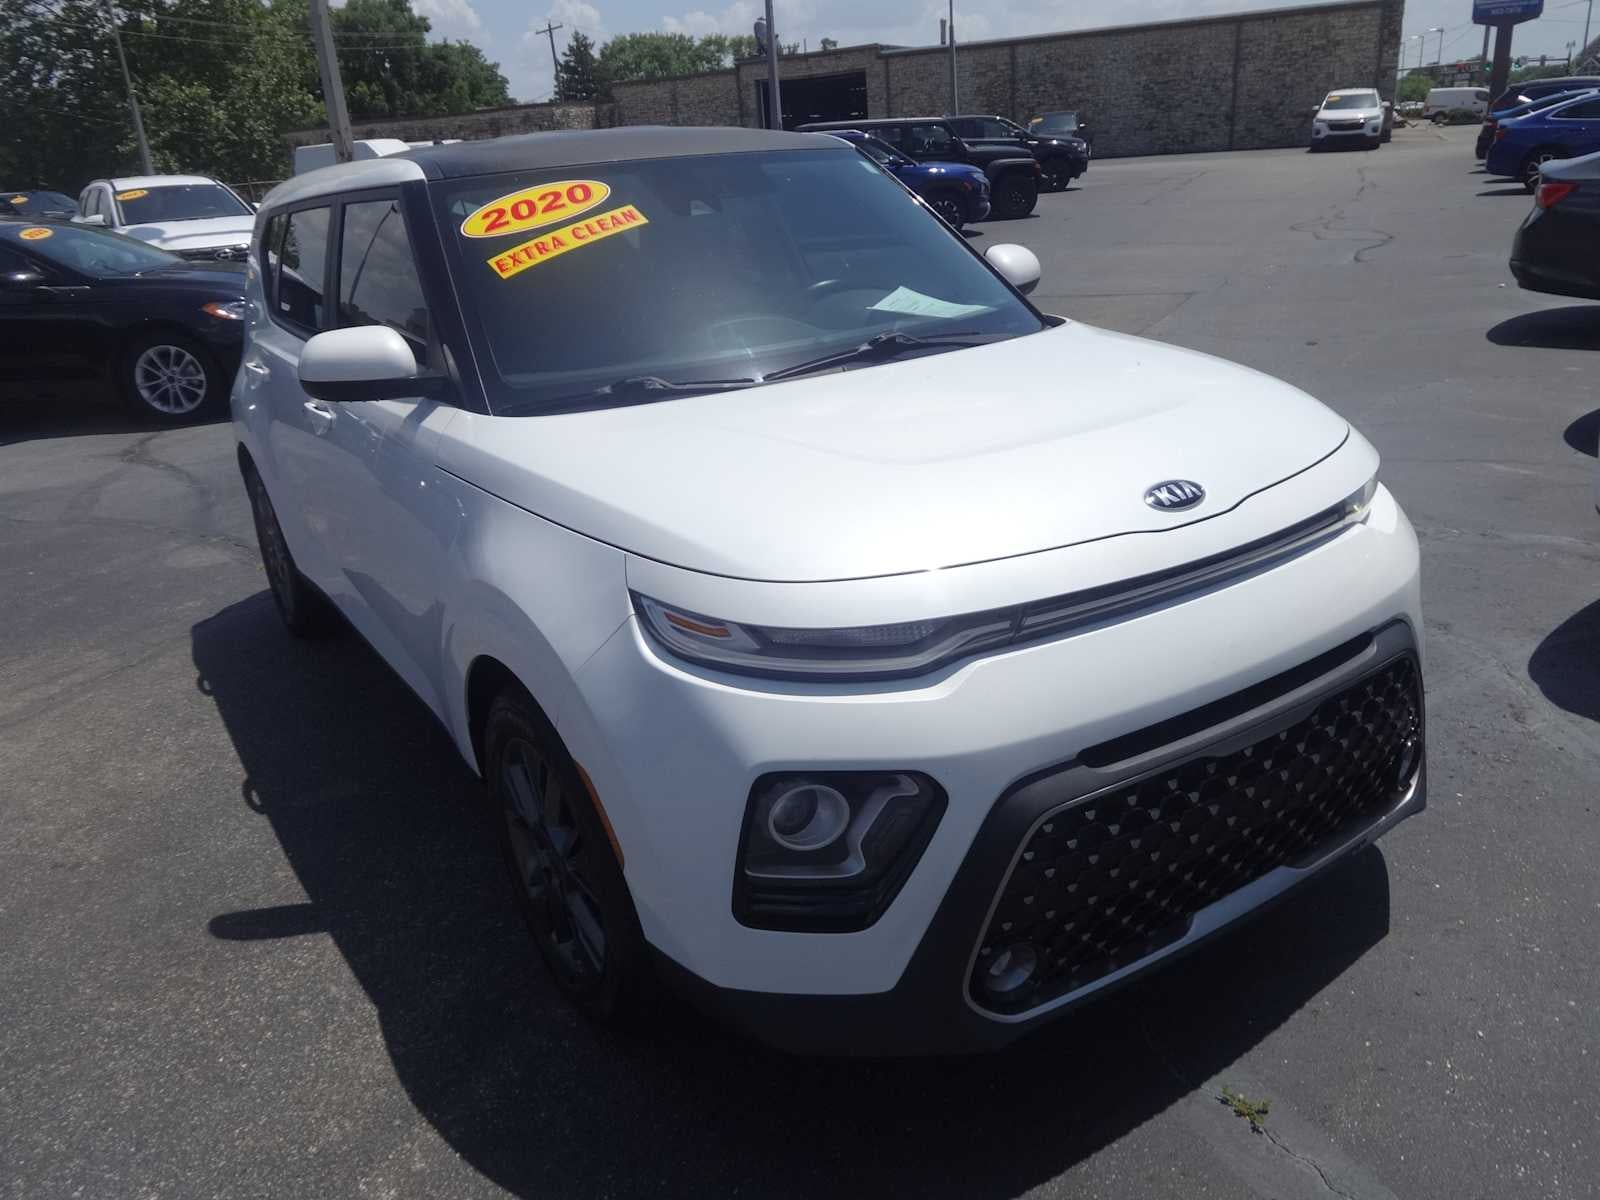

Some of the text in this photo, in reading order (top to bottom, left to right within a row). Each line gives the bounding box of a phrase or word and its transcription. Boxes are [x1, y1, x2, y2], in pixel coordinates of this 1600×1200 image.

[481, 183, 592, 233] 2020
[494, 209, 639, 273] EXTRA CLEAN
[1151, 481, 1203, 506] KIA
